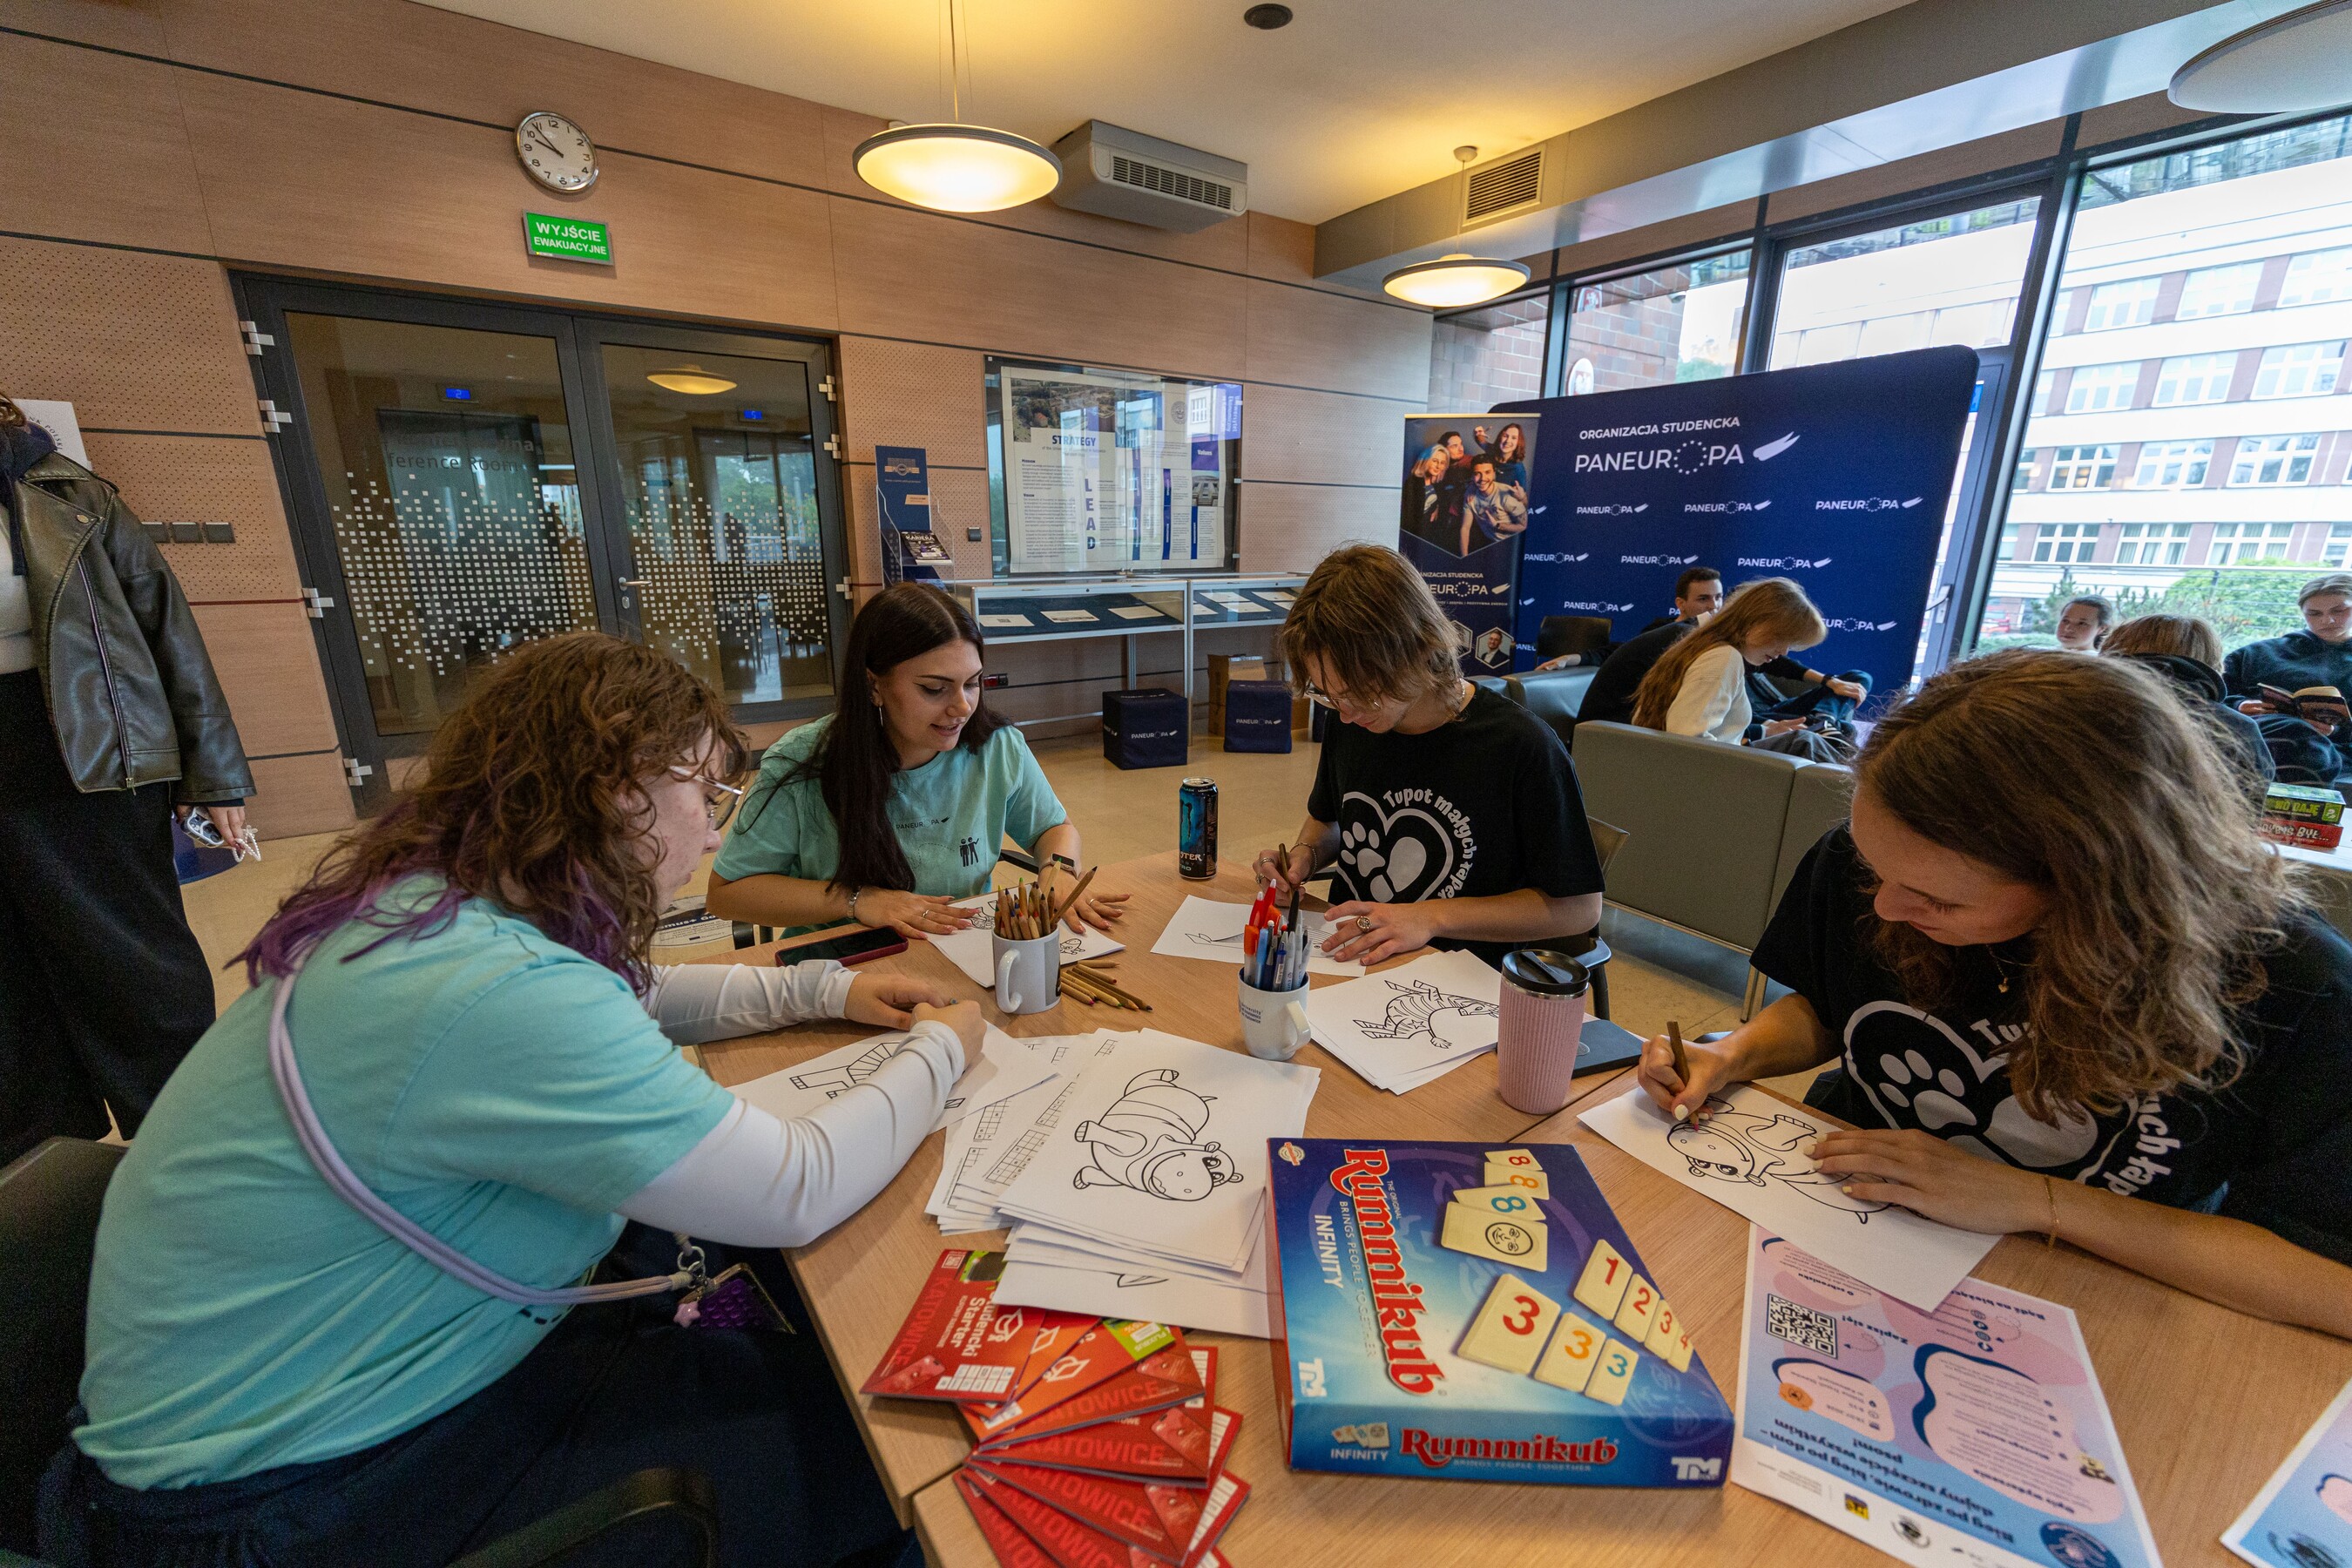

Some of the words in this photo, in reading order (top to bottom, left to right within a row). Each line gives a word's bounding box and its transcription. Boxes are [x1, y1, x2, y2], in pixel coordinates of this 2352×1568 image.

[536, 221, 601, 242] WYJŚCIE
[534, 236, 607, 255] EWAKUACYJNE
[1579, 424, 1659, 440] ORGANIZACJA
[1661, 416, 1740, 434] STUDENCKA
[1052, 435, 1096, 447] STRATEGY
[468, 456, 518, 472] Room
[1574, 440, 1745, 475] PANEUROPA
[1576, 504, 1632, 516] PANEUROPA
[1684, 500, 1753, 514] PANEUROPA
[1815, 497, 1899, 512] PANEUROPA
[1524, 551, 1575, 564] PANEUROPA
[1620, 554, 1681, 566] PANEUROPA
[1737, 556, 1811, 571] PANEUROPA
[1429, 581, 1488, 598] EUROPA
[1564, 601, 1619, 613] PANEUROPA
[1382, 787, 1434, 808] Tupot
[1434, 795, 1477, 859] małych
[1508, 1156, 1531, 1166] 8
[1510, 1174, 1539, 1189] 8
[1490, 1196, 1527, 1213] 8
[1314, 1214, 1344, 1289] INFINITY
[1339, 1201, 1355, 1238] BRINGS
[1348, 1242, 1363, 1283] PEOPLE
[1329, 1148, 1449, 1396] Rummikub
[1605, 1256, 1619, 1286] 1
[1632, 1287, 1651, 1316] 2
[1659, 1310, 1673, 1334] 3
[1995, 1301, 2011, 1310] na
[894, 1276, 951, 1365] KATOWICE
[950, 1297, 986, 1348] Starter
[1842, 1312, 1863, 1328] się!
[1503, 1295, 1540, 1335] 3
[1565, 1329, 1593, 1360] 3
[1607, 1354, 1629, 1377] 3
[1866, 1322, 1908, 1345] Zapisz
[1400, 1427, 1619, 1468] Rummikub
[1769, 1430, 1804, 1454] dom
[1851, 1433, 1903, 1468] psom!
[1330, 1448, 1389, 1462] INFINITY
[1808, 1444, 1828, 1463] po
[1495, 1459, 1533, 1470] PEOPLE
[1537, 1462, 1592, 1472] TOGETHER
[1830, 1454, 1867, 1482] bieg
[1937, 1484, 1995, 1521] dajmy
[1944, 1501, 1969, 1523] po
